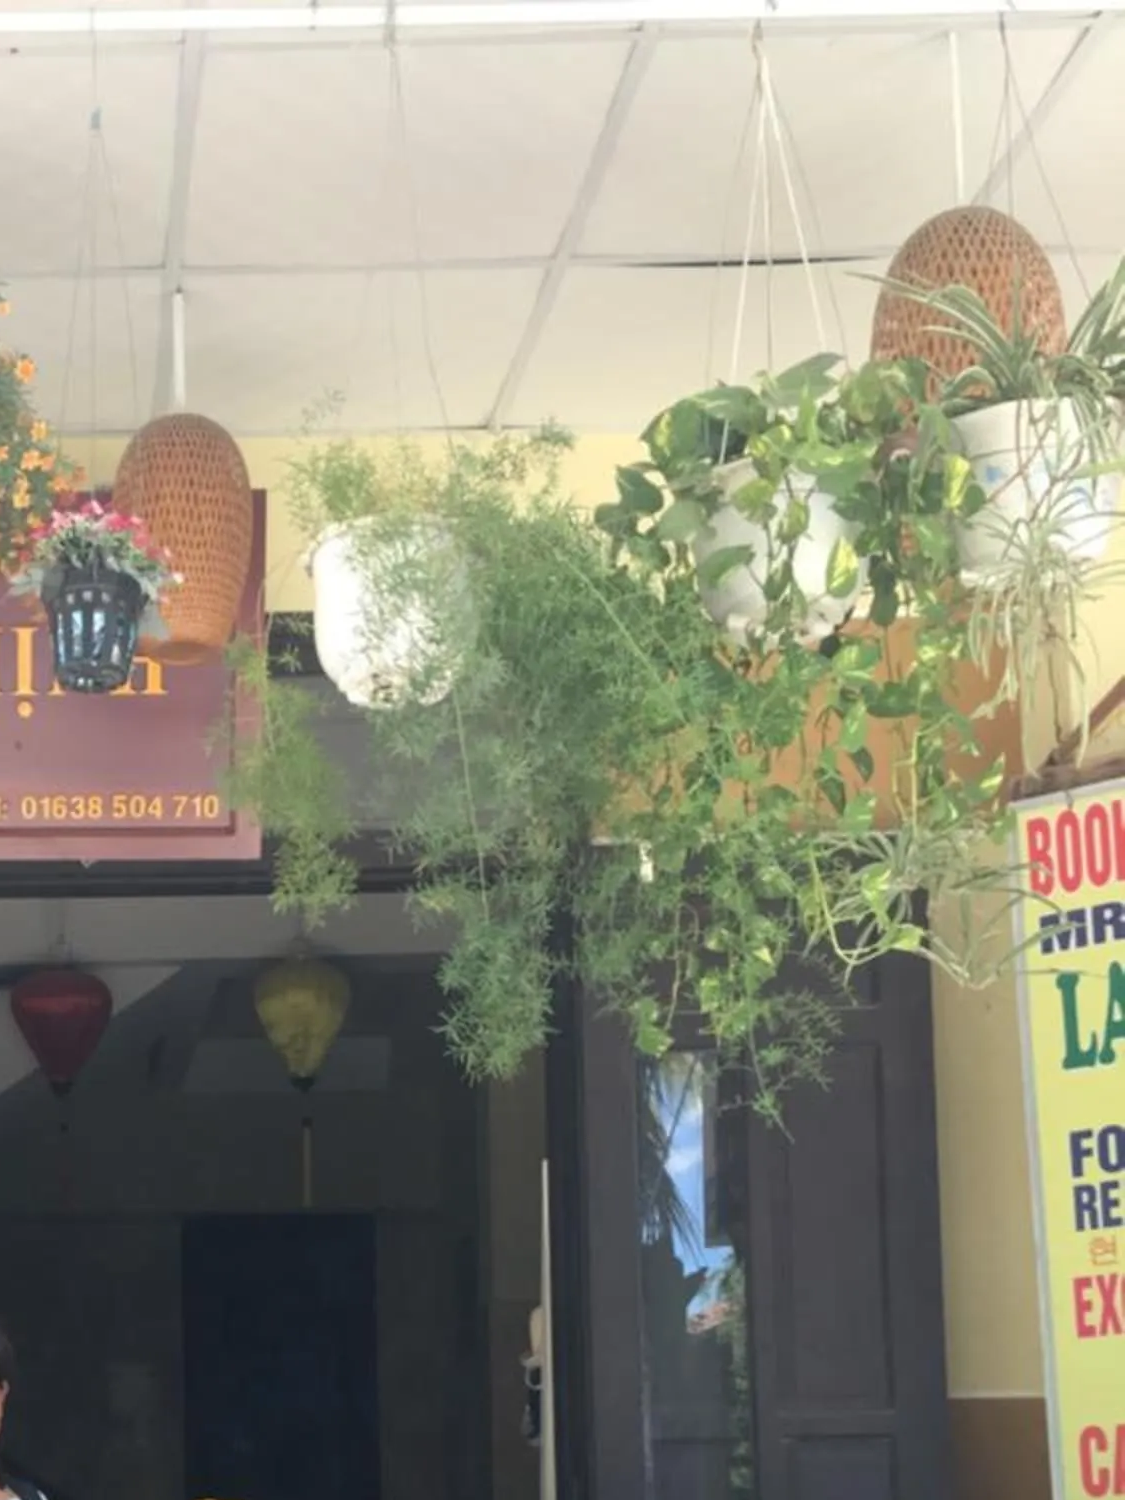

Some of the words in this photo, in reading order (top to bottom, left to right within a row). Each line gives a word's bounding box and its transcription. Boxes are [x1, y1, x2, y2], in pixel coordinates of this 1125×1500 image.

[20, 796, 104, 820] 01638
[111, 796, 163, 820] 504
[173, 795, 220, 820] 710
[1039, 901, 1125, 955] MR
[1069, 1124, 1125, 1178] FO
[1073, 1181, 1124, 1232] RE
[1073, 1273, 1125, 1339] EX
